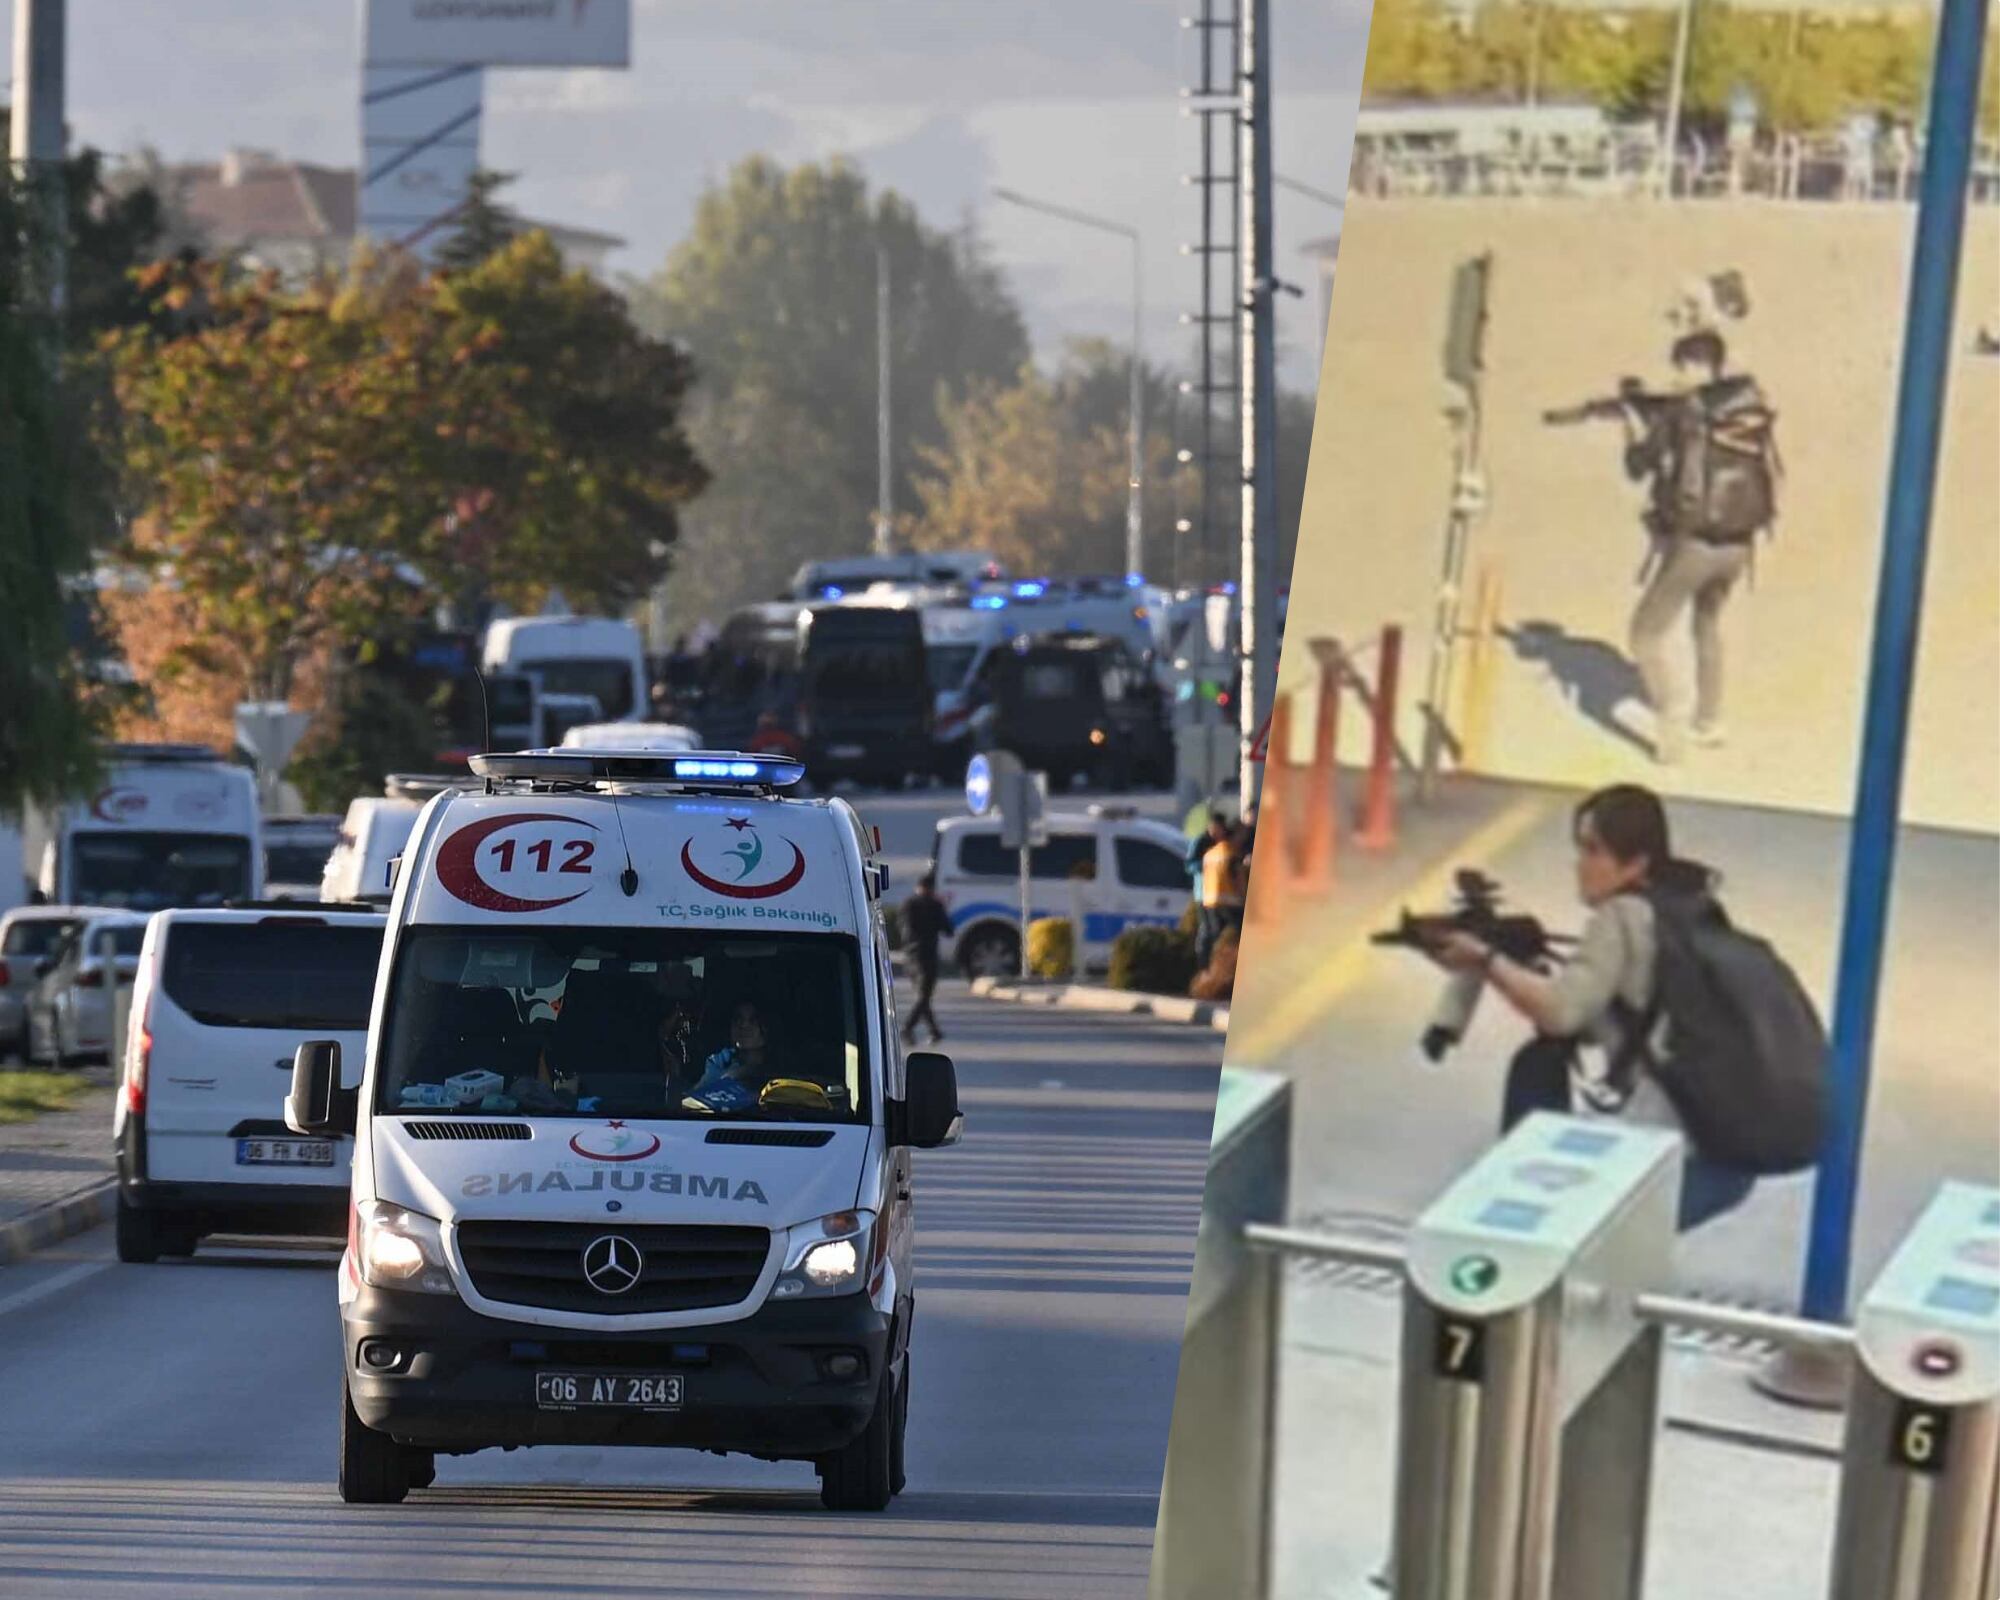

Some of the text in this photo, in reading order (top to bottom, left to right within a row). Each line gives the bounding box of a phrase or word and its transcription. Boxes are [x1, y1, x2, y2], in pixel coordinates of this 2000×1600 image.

[491, 839, 594, 873] 112
[689, 904, 746, 919] Sağlık
[753, 906, 838, 927] Bakanlığı
[1447, 1325, 1472, 1369] 7
[551, 1377, 679, 1403] 06 AY 2643
[1905, 1414, 1933, 1461] 6
